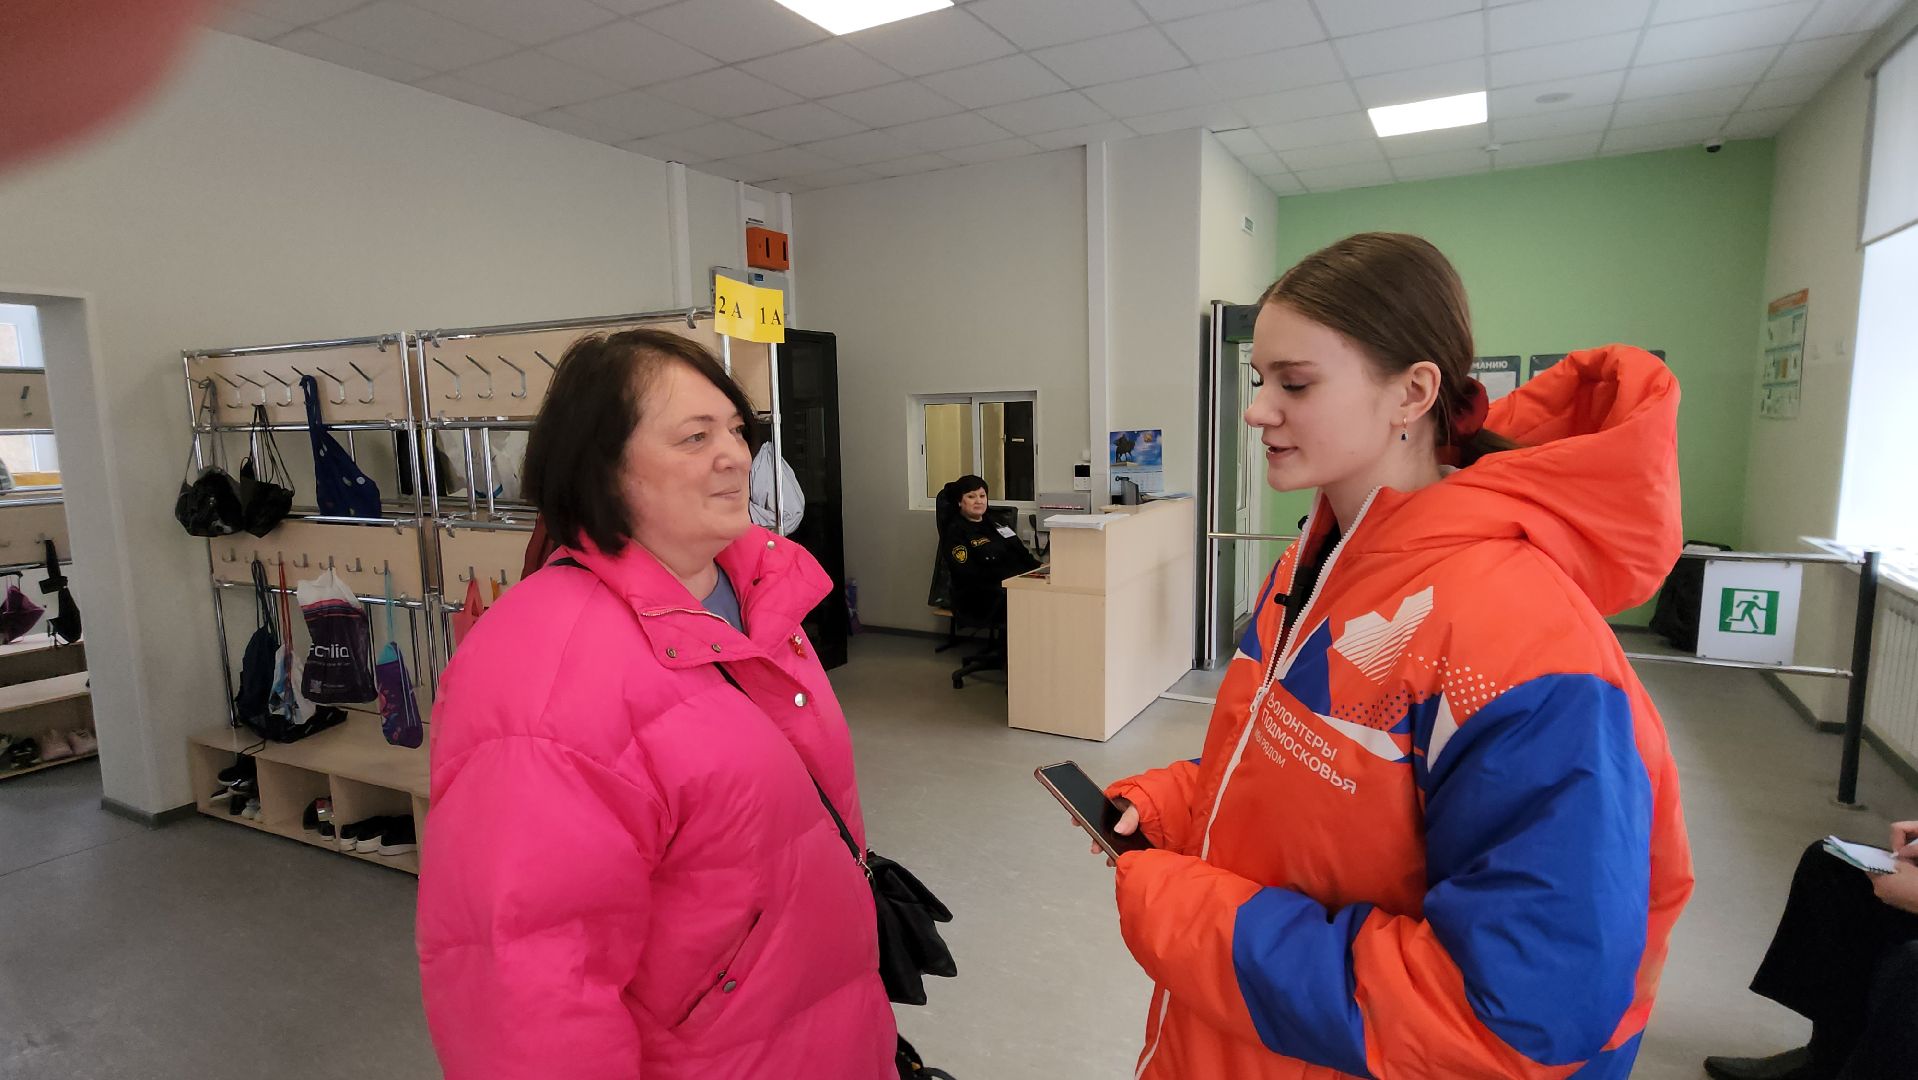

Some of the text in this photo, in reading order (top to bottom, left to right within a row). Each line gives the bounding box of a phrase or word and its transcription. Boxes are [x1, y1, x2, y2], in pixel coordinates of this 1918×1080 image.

[1260, 738, 1286, 768] РЯДОМ
[1261, 708, 1357, 795] ПОДМОСКОВЬЯ
[1267, 692, 1338, 762] ВОЛОНТЕРЫ
